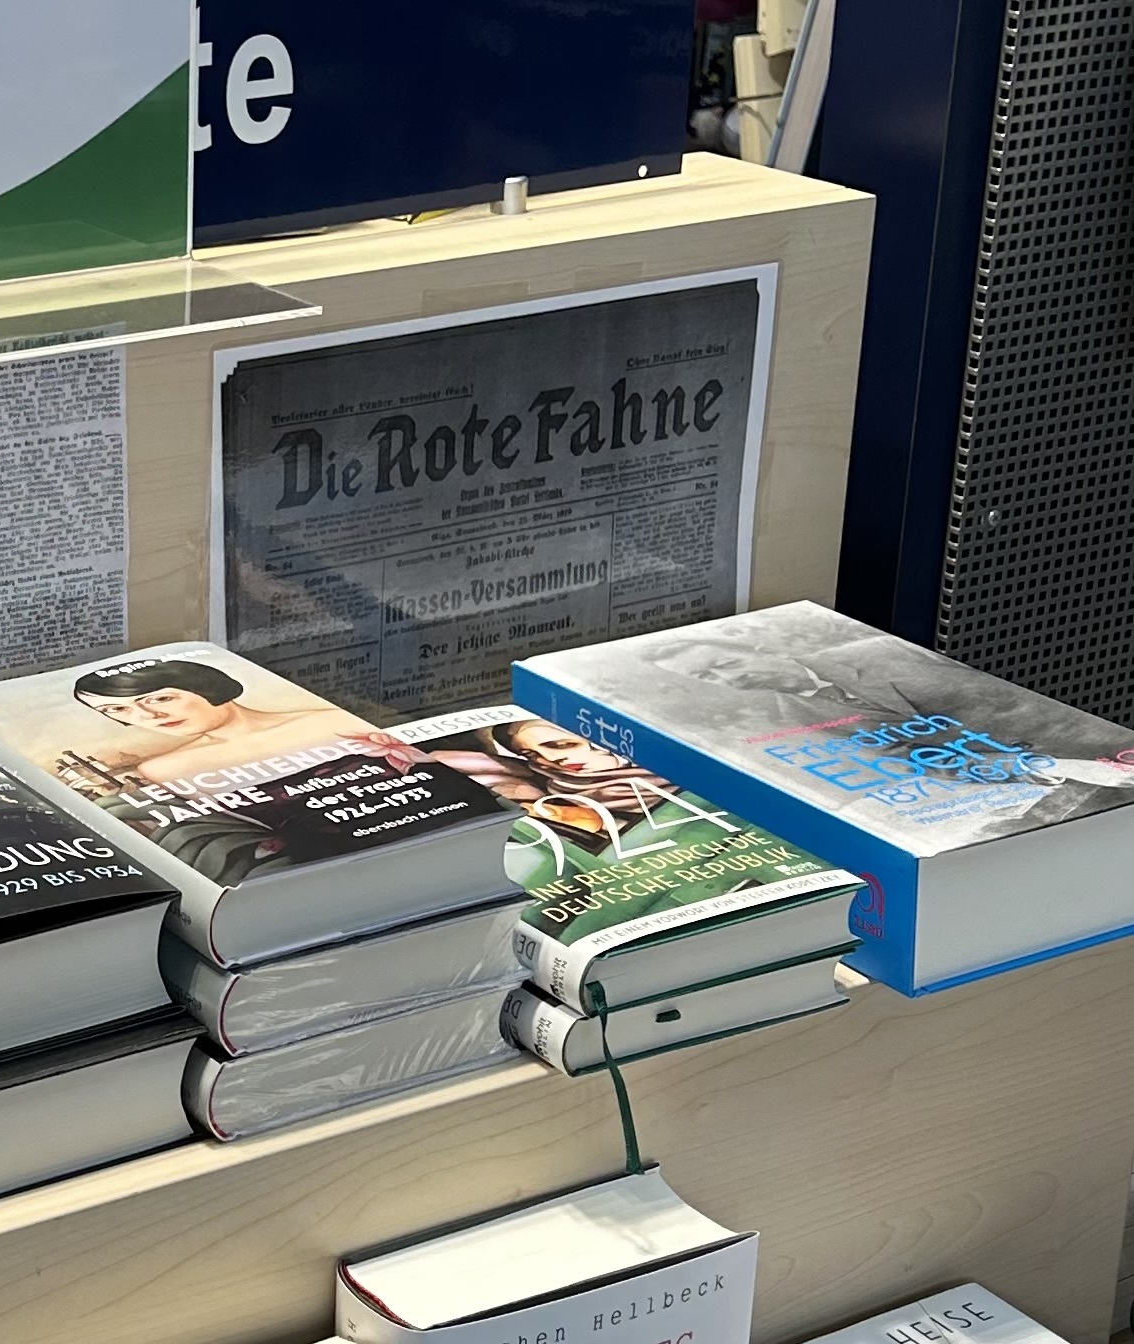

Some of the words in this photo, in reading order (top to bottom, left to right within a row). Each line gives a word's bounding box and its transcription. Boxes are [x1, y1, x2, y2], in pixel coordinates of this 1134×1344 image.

[272, 428, 364, 510] Die
[367, 403, 522, 495] Rote
[529, 377, 724, 464] Fahne
[764, 713, 963, 765] Friedrich
[119, 736, 368, 810] LEUCHTENDE
[282, 759, 383, 800] Aufbruch
[304, 786, 343, 812] der
[346, 768, 435, 803] Frauen
[146, 784, 275, 830] JAHRE
[541, 876, 676, 924] DEUTSCHE
[678, 845, 802, 890] REPUBLIK
[592, 1273, 726, 1332] Hellbeck
